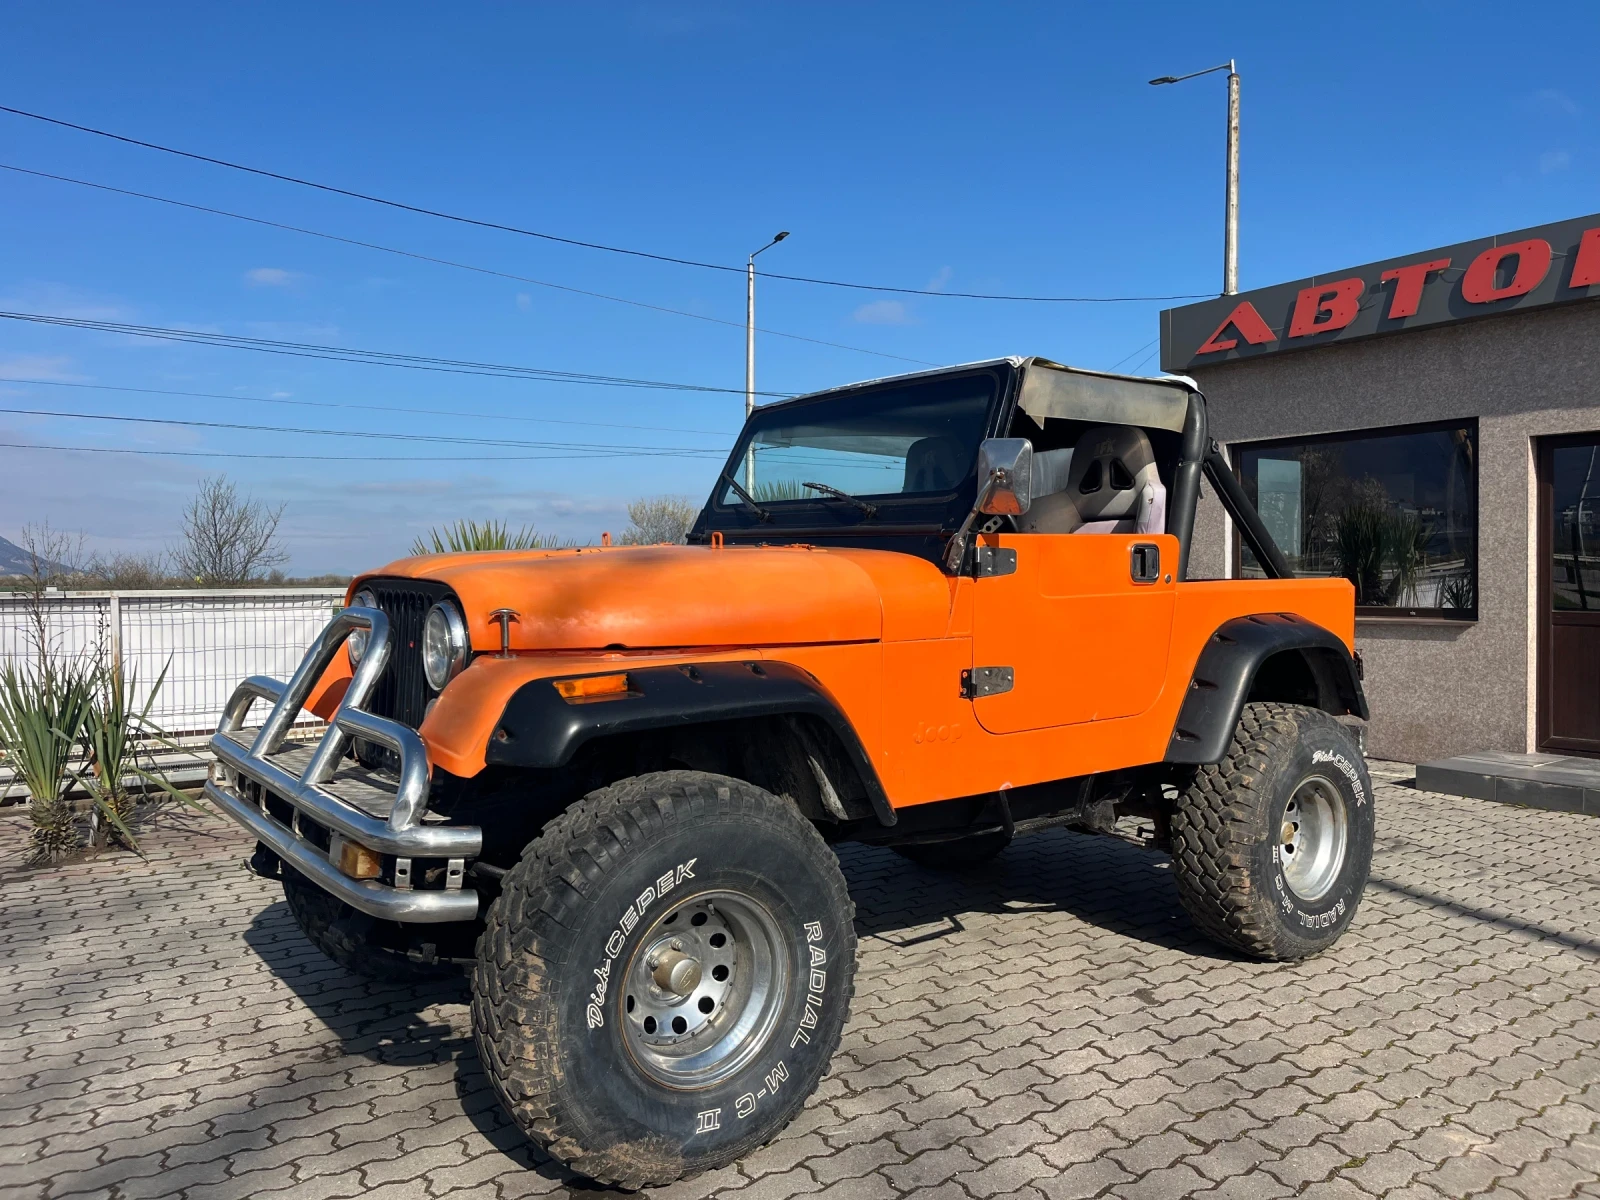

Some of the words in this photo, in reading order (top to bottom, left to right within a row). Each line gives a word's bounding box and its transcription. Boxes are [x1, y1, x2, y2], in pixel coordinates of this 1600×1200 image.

[1333, 753, 1366, 807] CEPEK
[605, 857, 697, 959] CEPEK
[1297, 898, 1346, 929] RADIAL
[789, 920, 826, 1049] RADIAL
